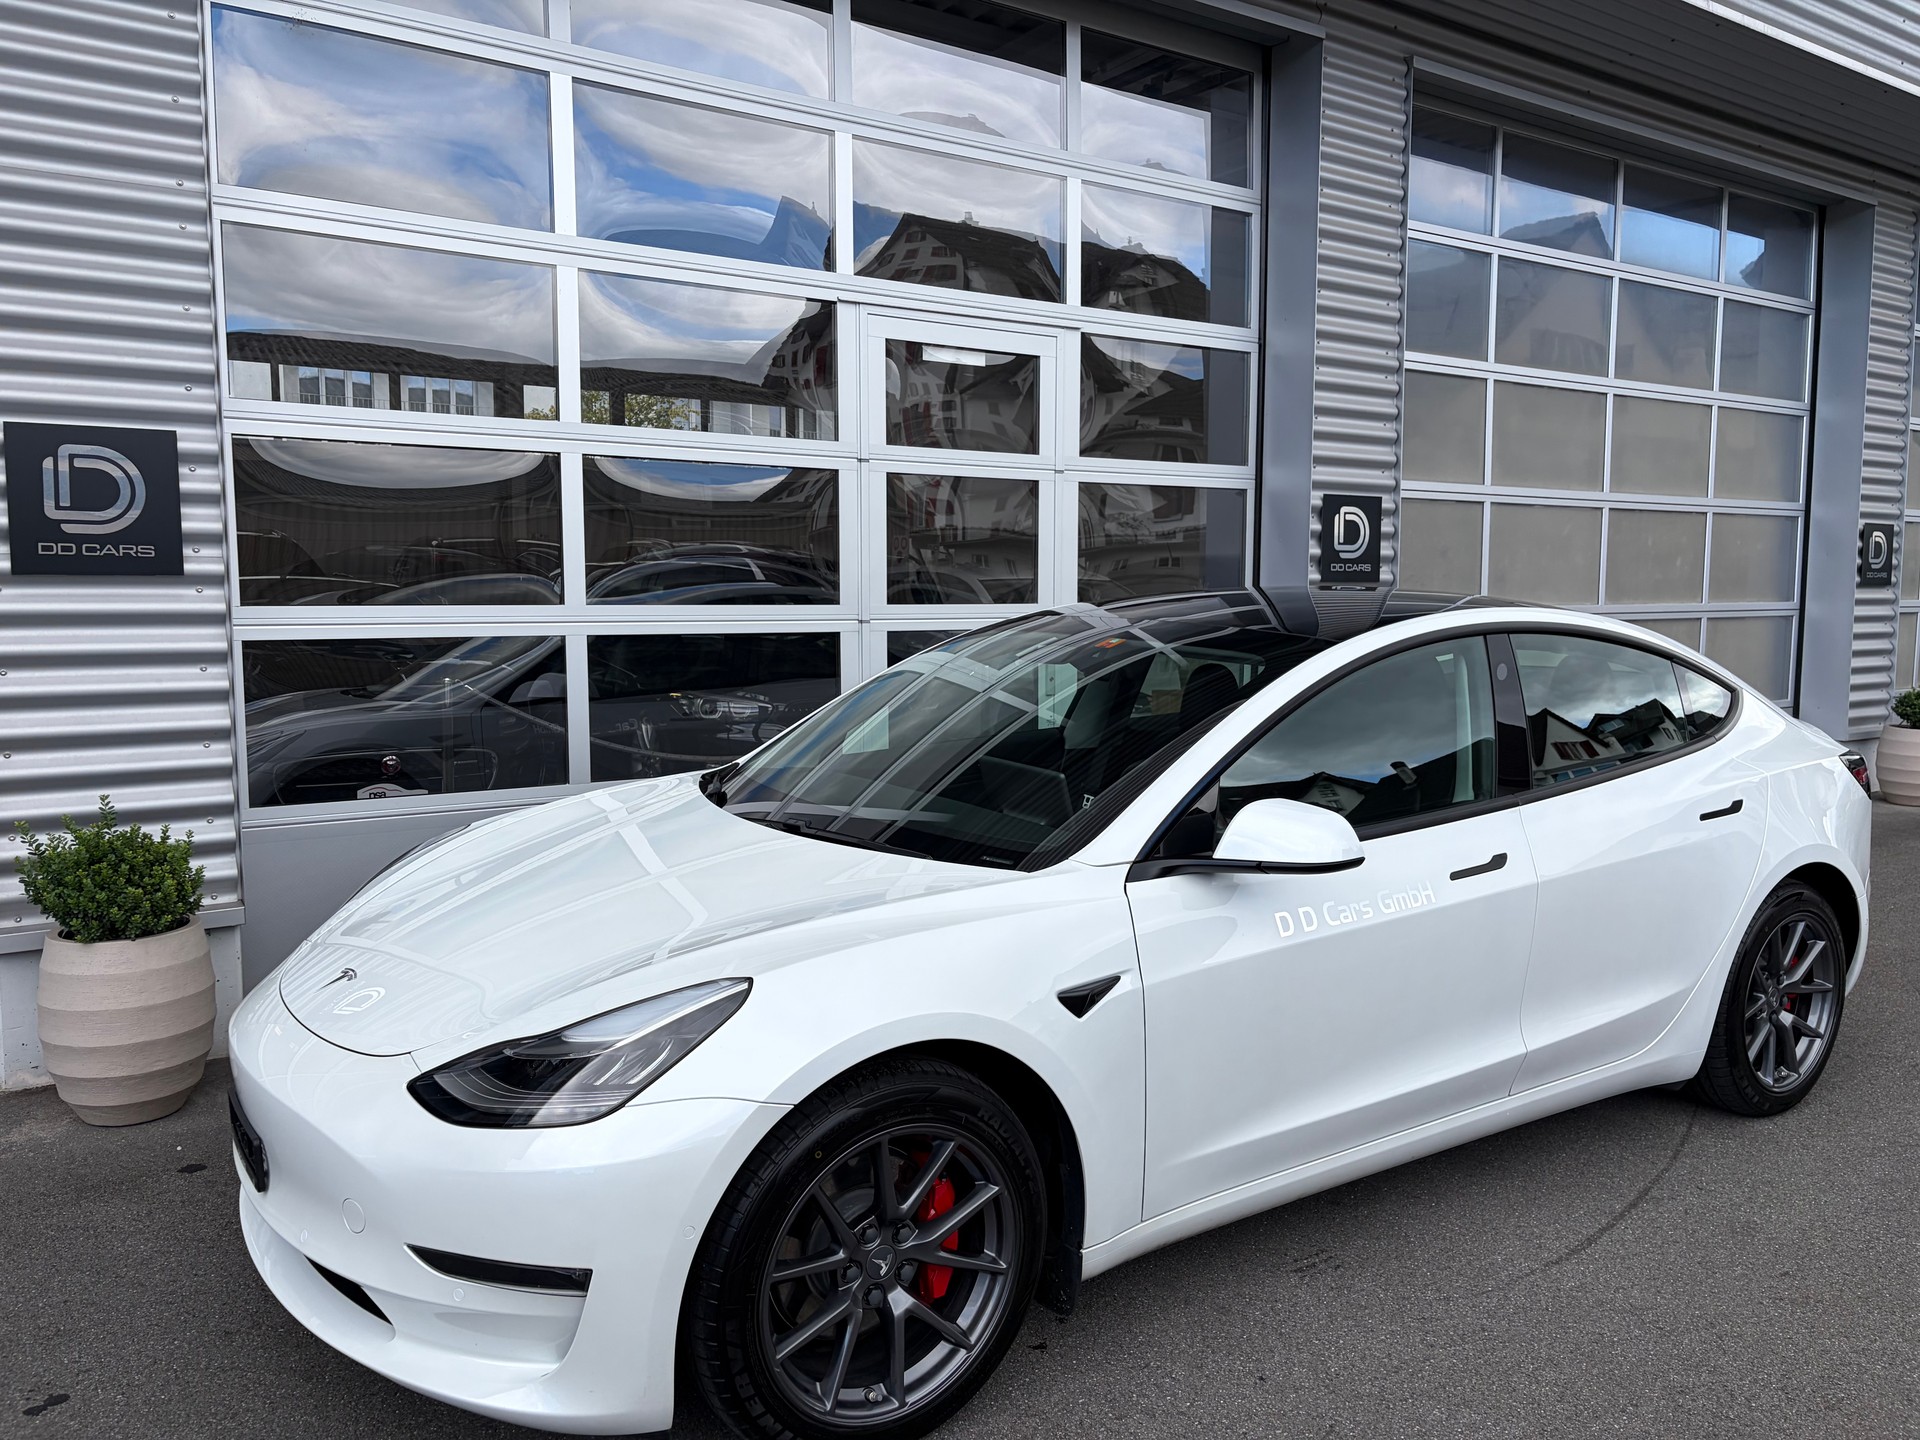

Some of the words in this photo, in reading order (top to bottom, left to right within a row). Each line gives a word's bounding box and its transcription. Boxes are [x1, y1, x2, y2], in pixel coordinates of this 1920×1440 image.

[37, 542, 77, 556] DD
[82, 543, 156, 558] CARS
[1330, 563, 1345, 572] DD
[1345, 563, 1372, 572] CARS
[1274, 911, 1295, 938] D
[1297, 905, 1318, 933] D
[1322, 901, 1374, 927] Cars
[1376, 880, 1437, 915] GmbH
